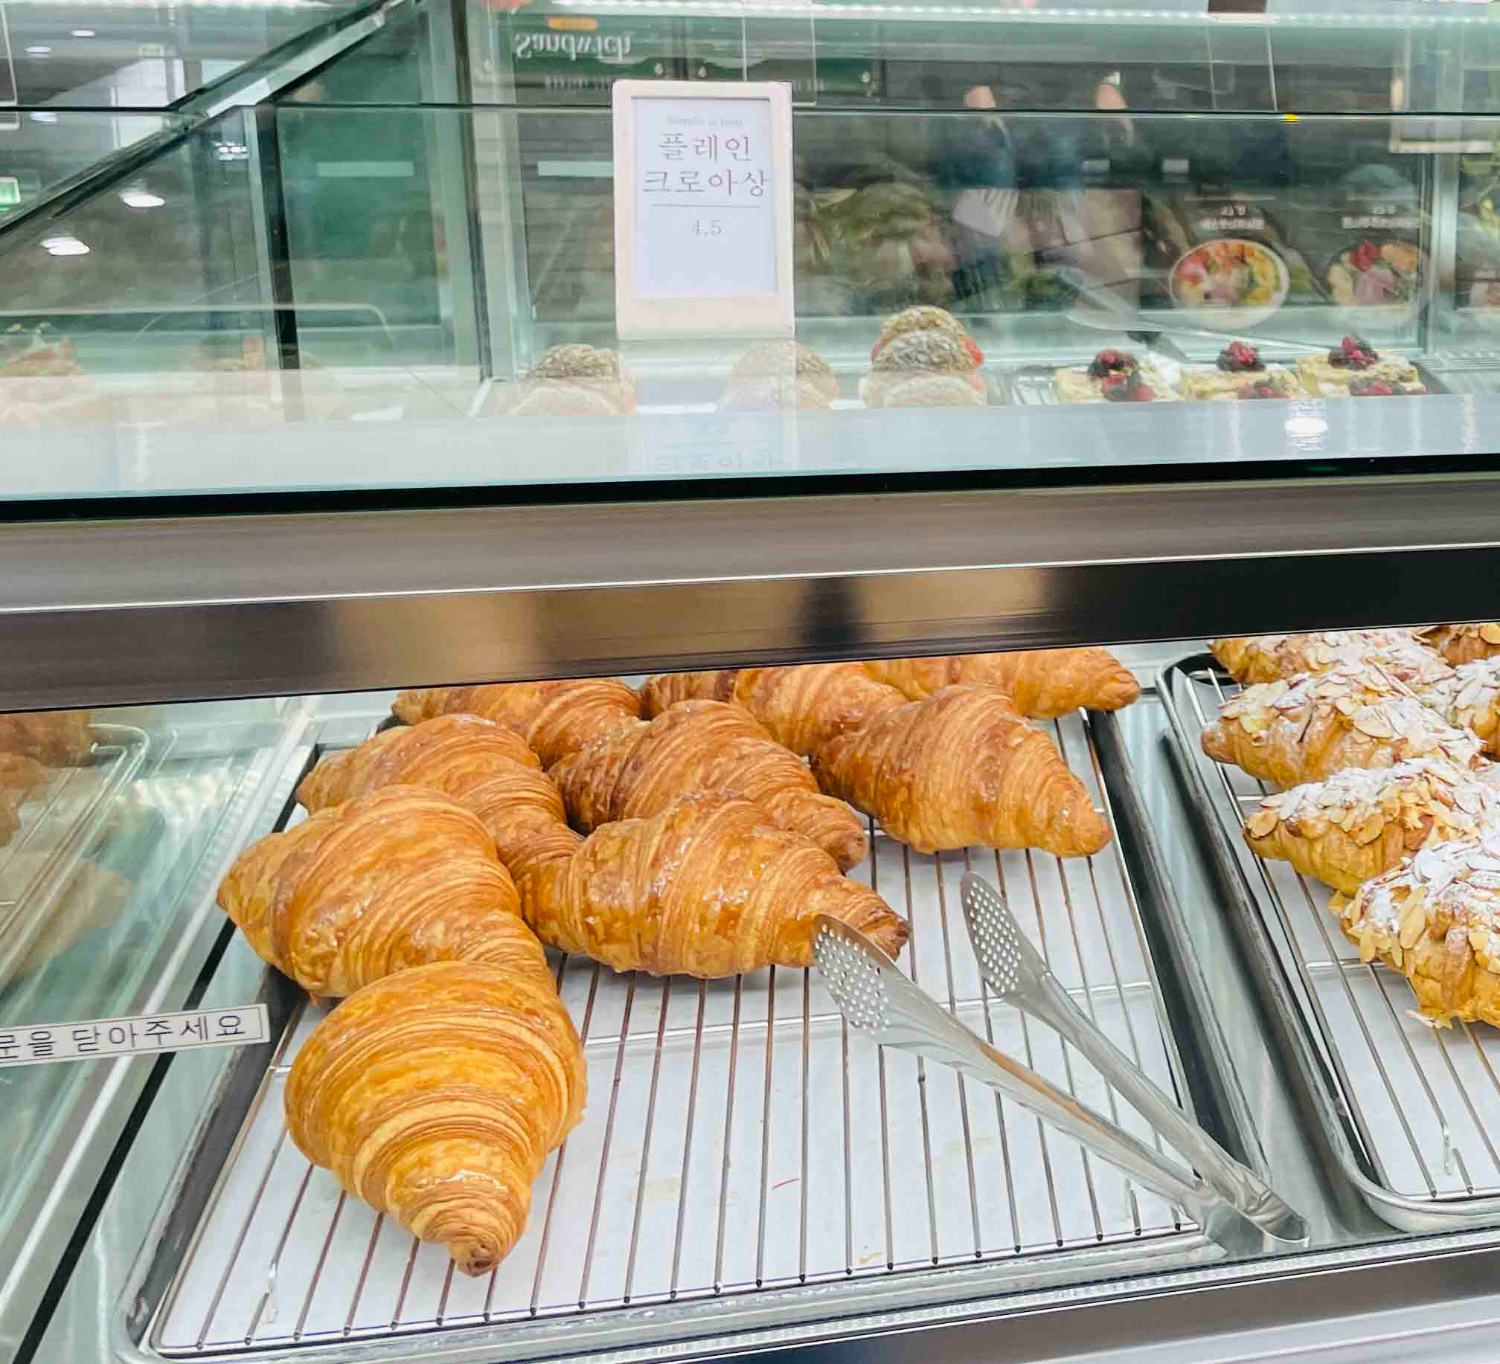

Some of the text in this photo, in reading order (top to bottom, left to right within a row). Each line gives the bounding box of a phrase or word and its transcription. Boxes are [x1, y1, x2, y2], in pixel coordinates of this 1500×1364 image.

[658, 132, 752, 163] 플레인
[642, 168, 771, 197] 크로아상
[0, 1014, 246, 1059] 문을 닫아주세요
